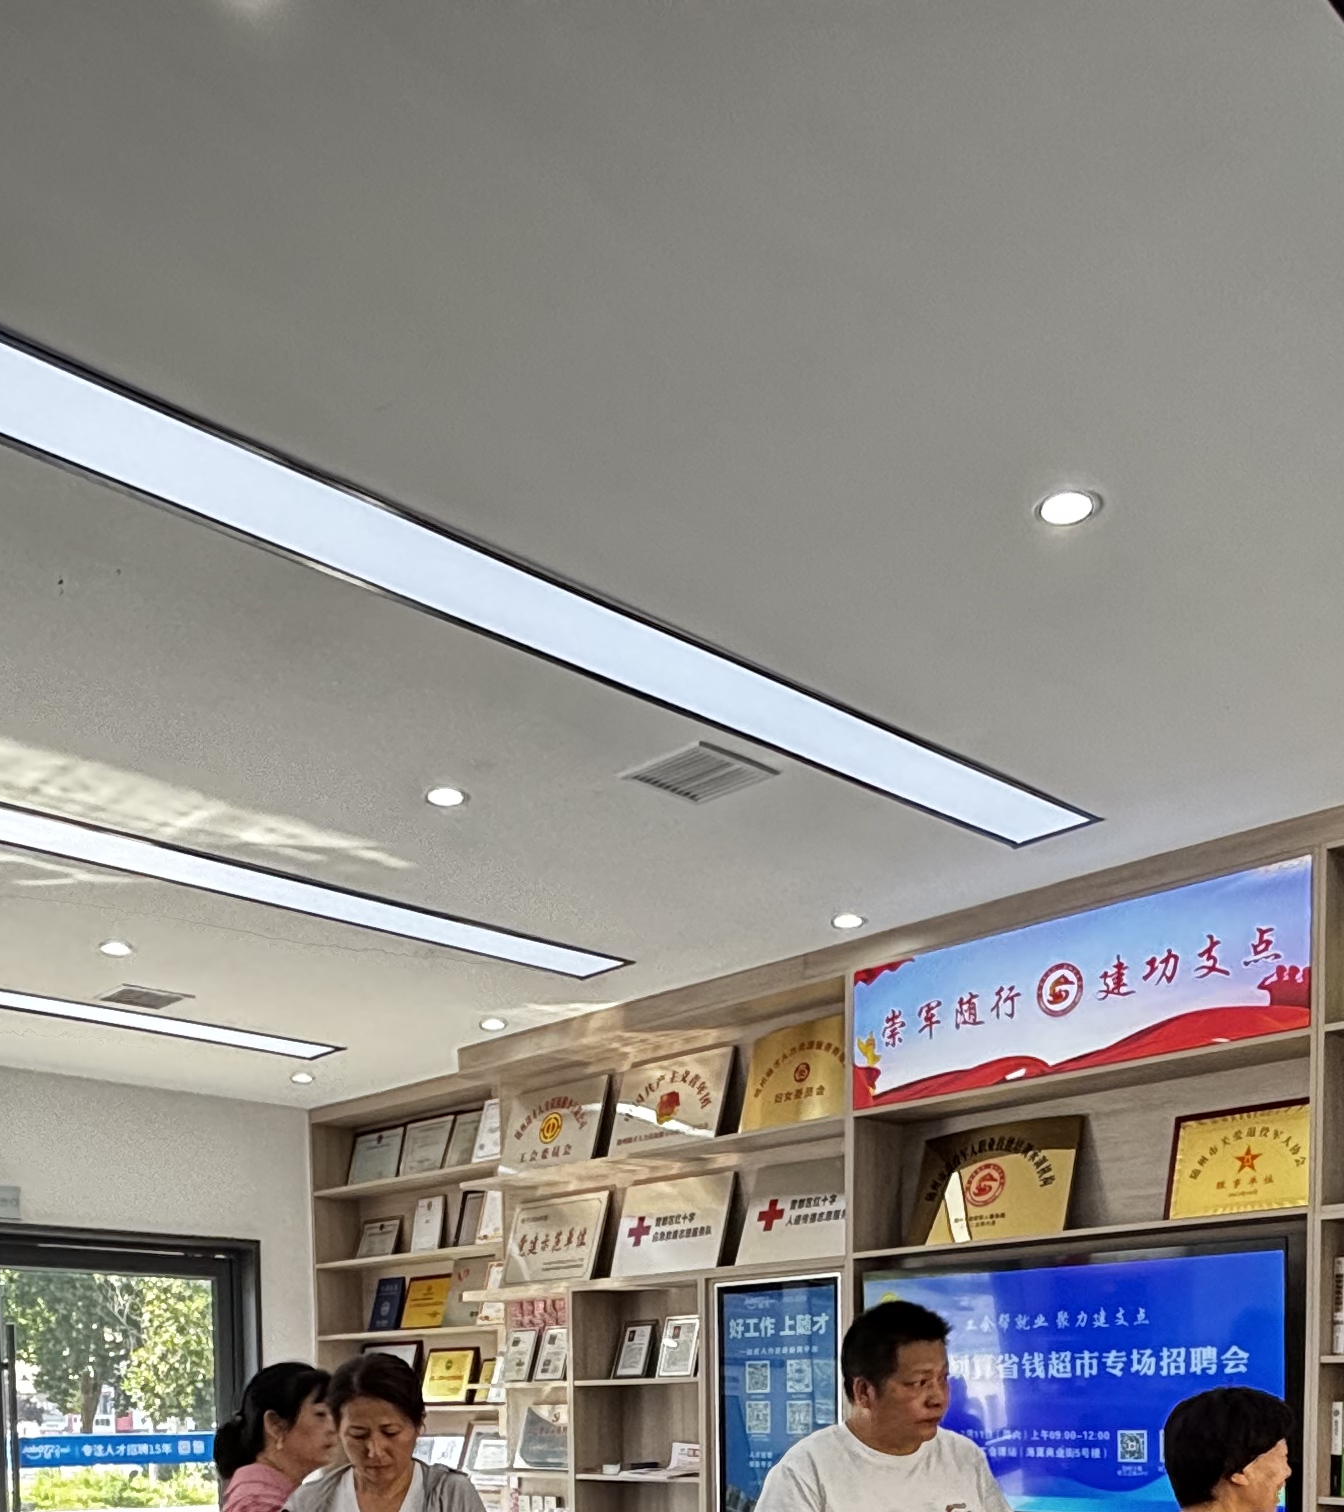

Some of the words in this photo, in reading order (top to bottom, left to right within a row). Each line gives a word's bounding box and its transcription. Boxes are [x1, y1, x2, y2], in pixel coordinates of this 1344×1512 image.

[880, 985, 1023, 1048] 崇军随行
[1096, 926, 1282, 1001] 建功支点
[728, 1316, 777, 1340] 好工作
[779, 1312, 830, 1336] 上随才
[82, 1443, 172, 1457] 专注人才招聘15年
